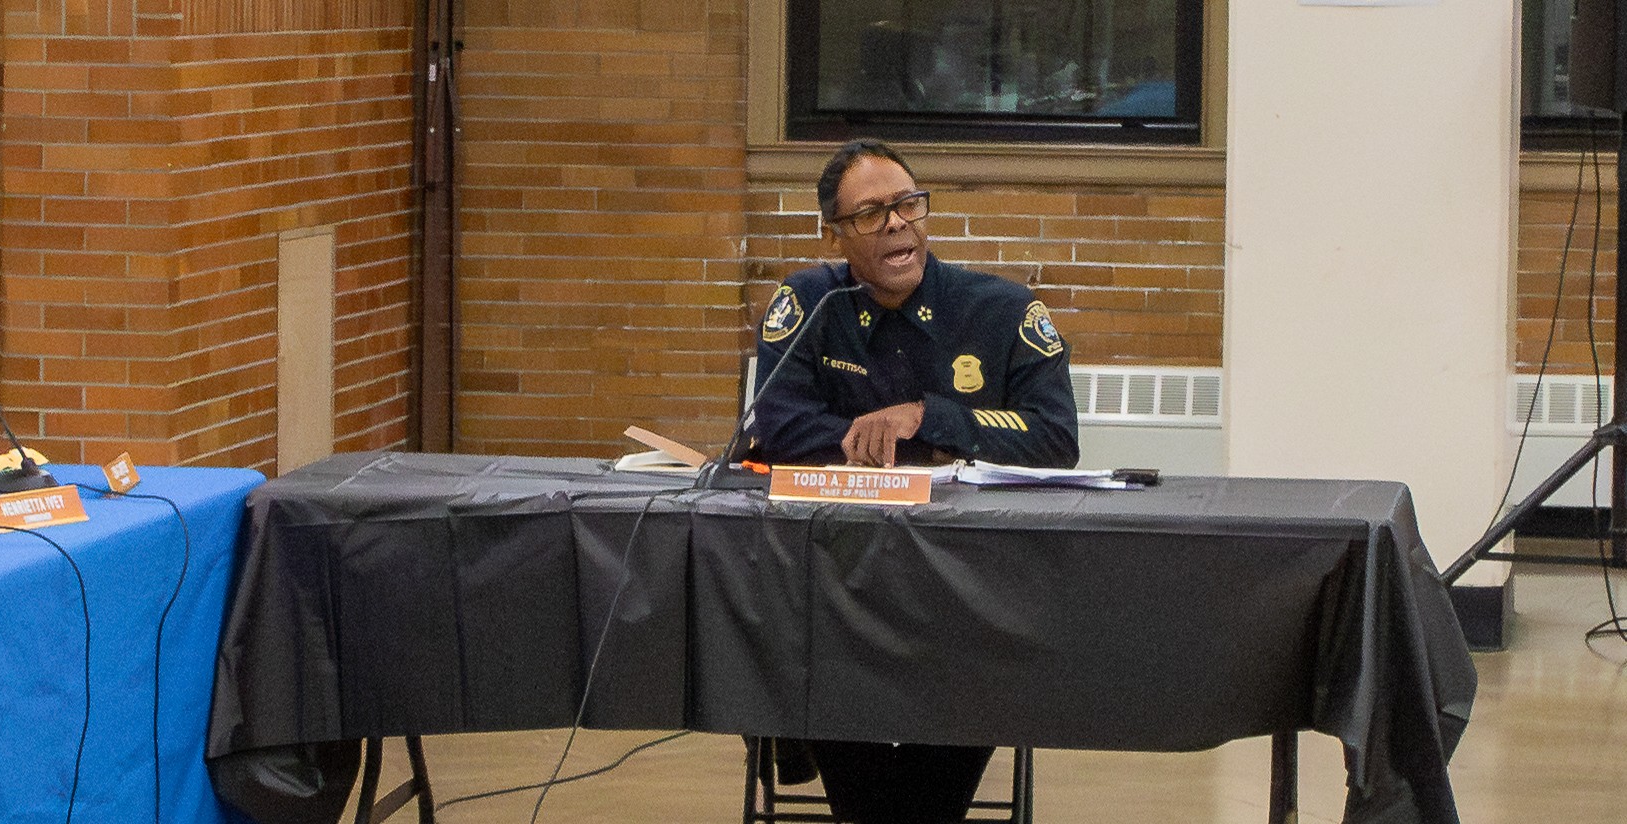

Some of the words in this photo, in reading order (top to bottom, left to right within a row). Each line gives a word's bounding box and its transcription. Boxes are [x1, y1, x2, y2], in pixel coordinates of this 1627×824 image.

[793, 472, 826, 486] TODD
[830, 474, 842, 487] A.
[847, 475, 910, 489] BETTISON
[819, 488, 840, 497] CHIEF
[842, 488, 852, 497] OF
[854, 489, 880, 498] POLICE
